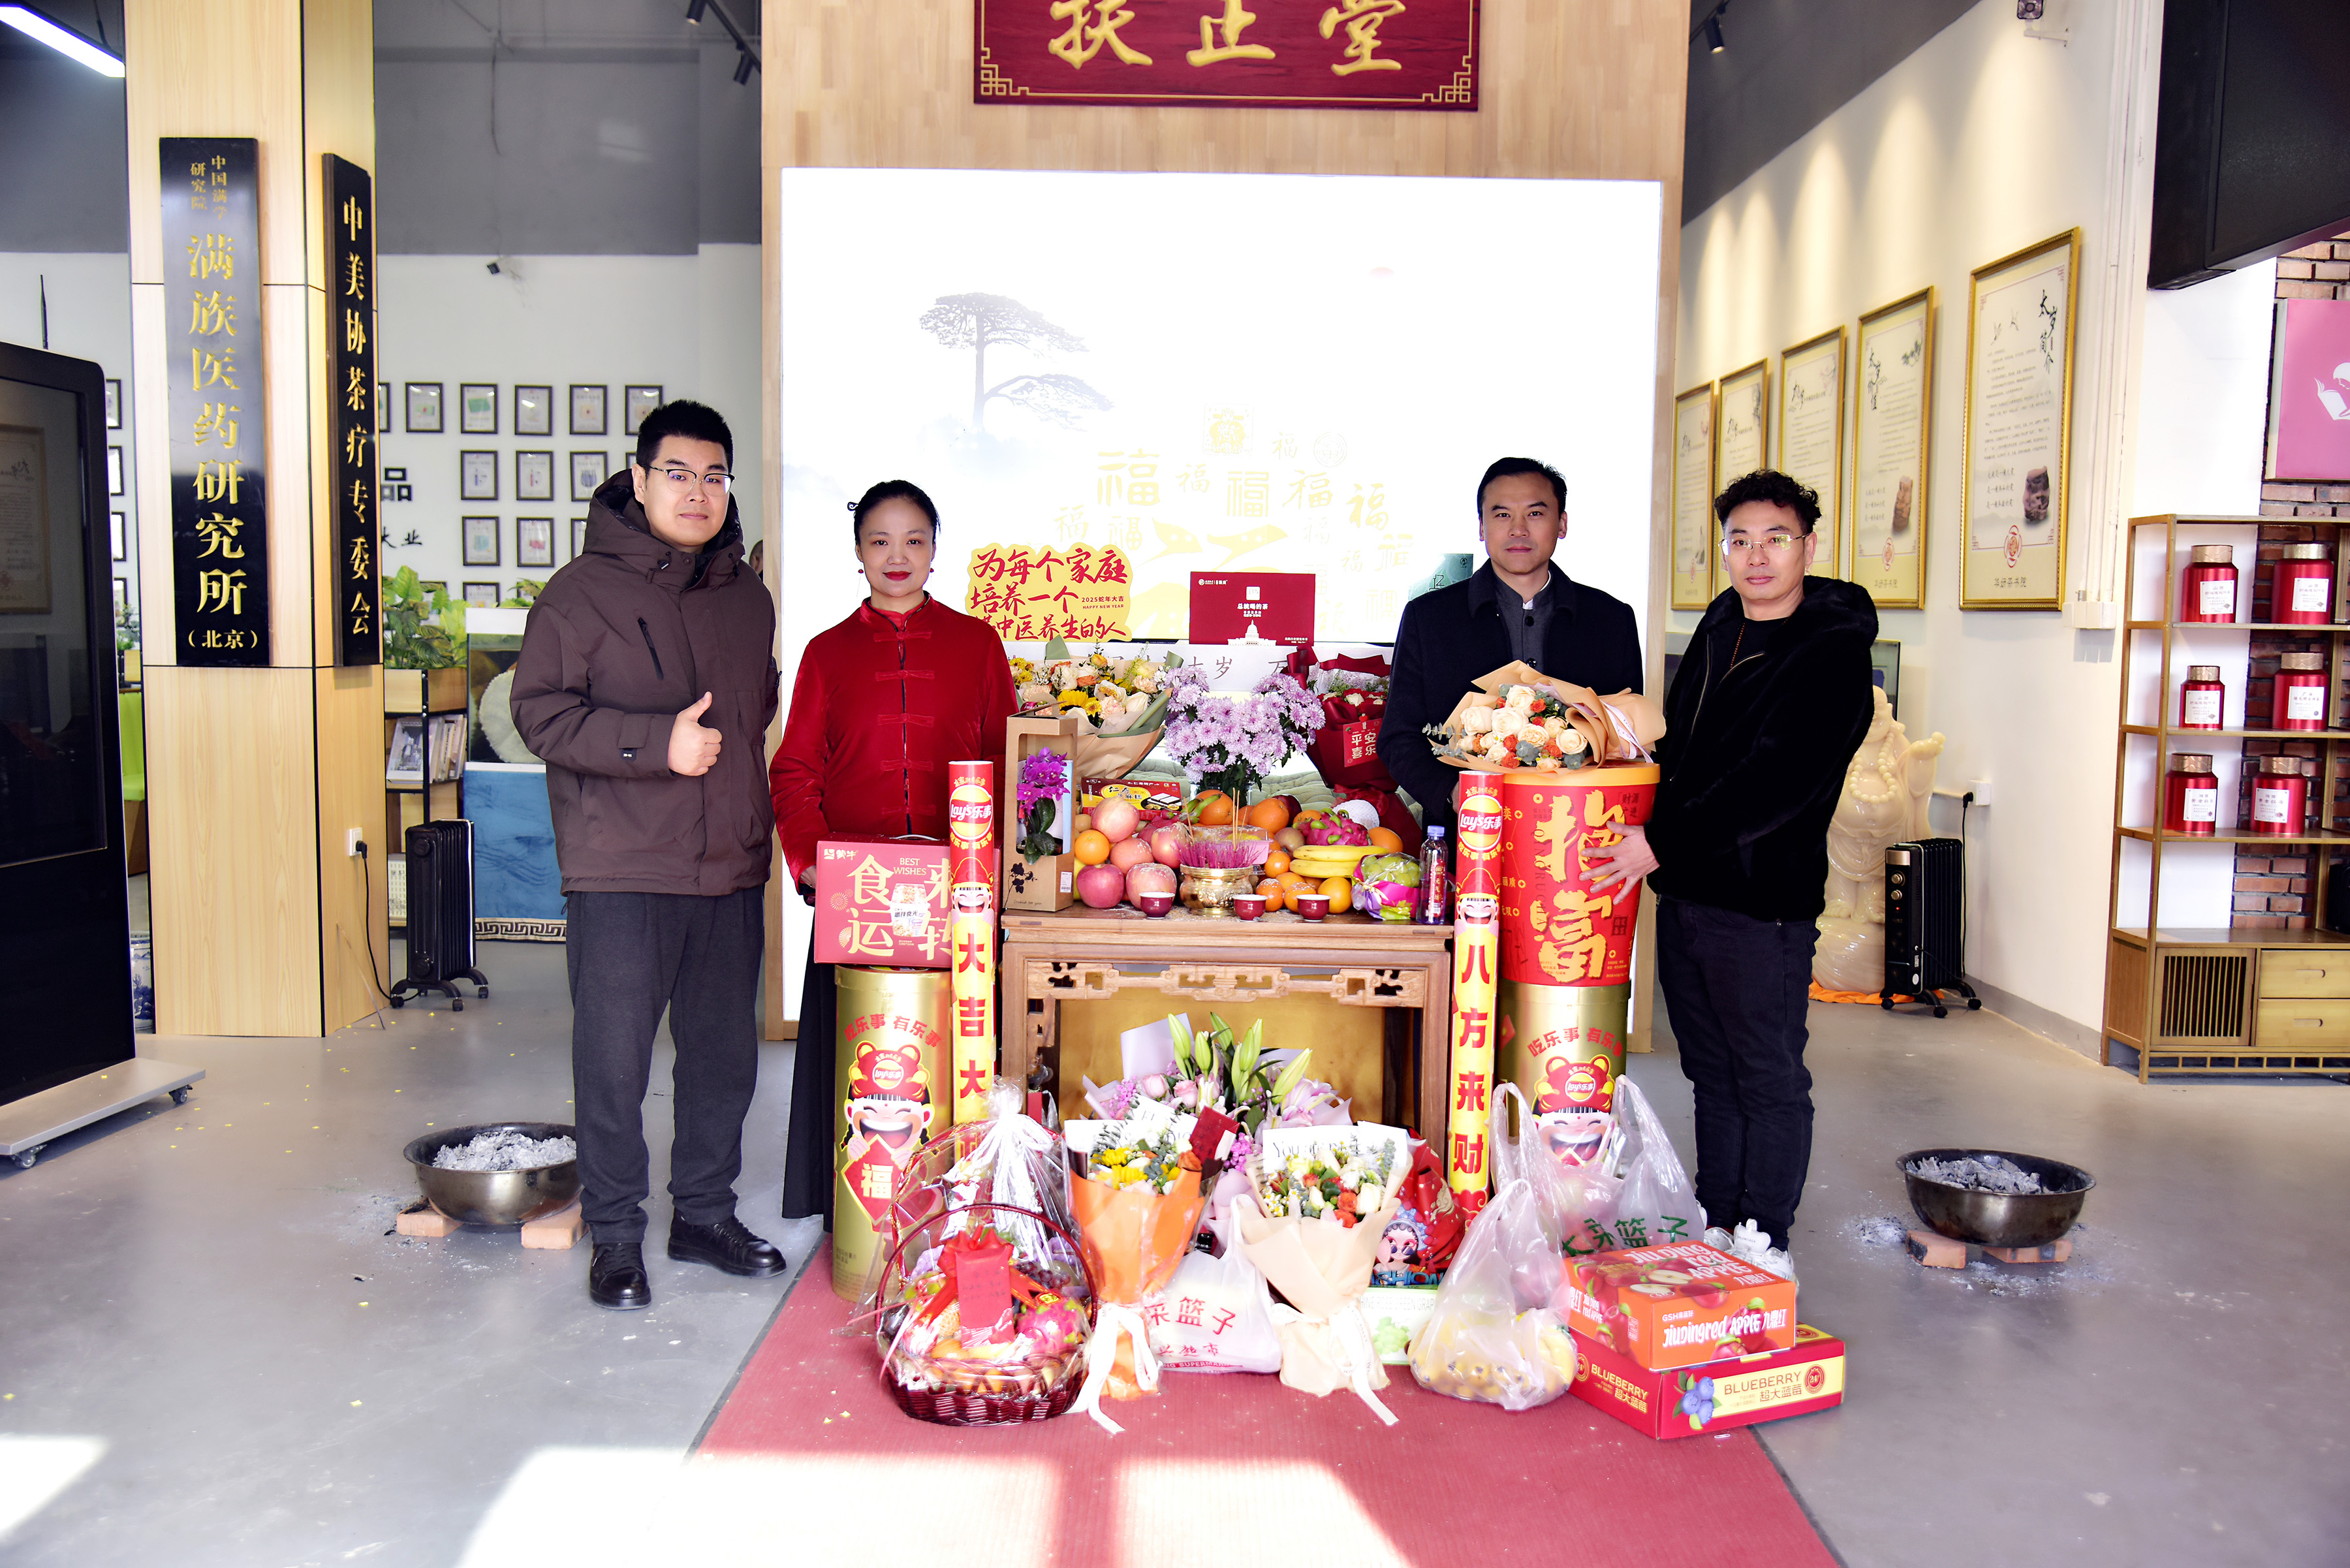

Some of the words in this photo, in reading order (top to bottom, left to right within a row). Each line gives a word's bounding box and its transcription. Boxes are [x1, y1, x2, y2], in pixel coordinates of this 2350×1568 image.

[187, 232, 249, 616] 满族医药研究所
[343, 195, 371, 636] 中美协茶疗专委会
[1097, 448, 1160, 506] 福
[1283, 470, 1333, 509] 福
[973, 548, 1128, 584] 为每个家庭
[970, 581, 1079, 616] 培养一个
[976, 614, 1126, 642] 中医养生的人
[1351, 732, 1377, 746] 平安
[1351, 744, 1377, 759] 喜乐
[950, 804, 992, 821] Lay's乐事
[1460, 813, 1502, 831] Lay's乐事
[836, 849, 856, 860] 蒙牛
[900, 858, 920, 866] BEST
[894, 867, 927, 876] WISHES
[844, 1013, 886, 1043] 吃乐事
[893, 1015, 942, 1048] 有乐事
[1527, 1027, 1580, 1058] 吃乐事
[1453, 944, 1490, 1174] 八方来财
[860, 1163, 893, 1199] 福
[1687, 1262, 1753, 1279] APPLE
[1733, 1273, 1776, 1285] 九鼎红
[1730, 1313, 1761, 1336] APPLE
[1762, 1308, 1787, 1330] 九鼎红
[1591, 1363, 1648, 1400] BLUEBERRY
[1724, 1371, 1801, 1395] BLUEBERRY
[1759, 1383, 1802, 1403] 超大蓝莓
[1614, 1387, 1648, 1413] 超大蓝莓
